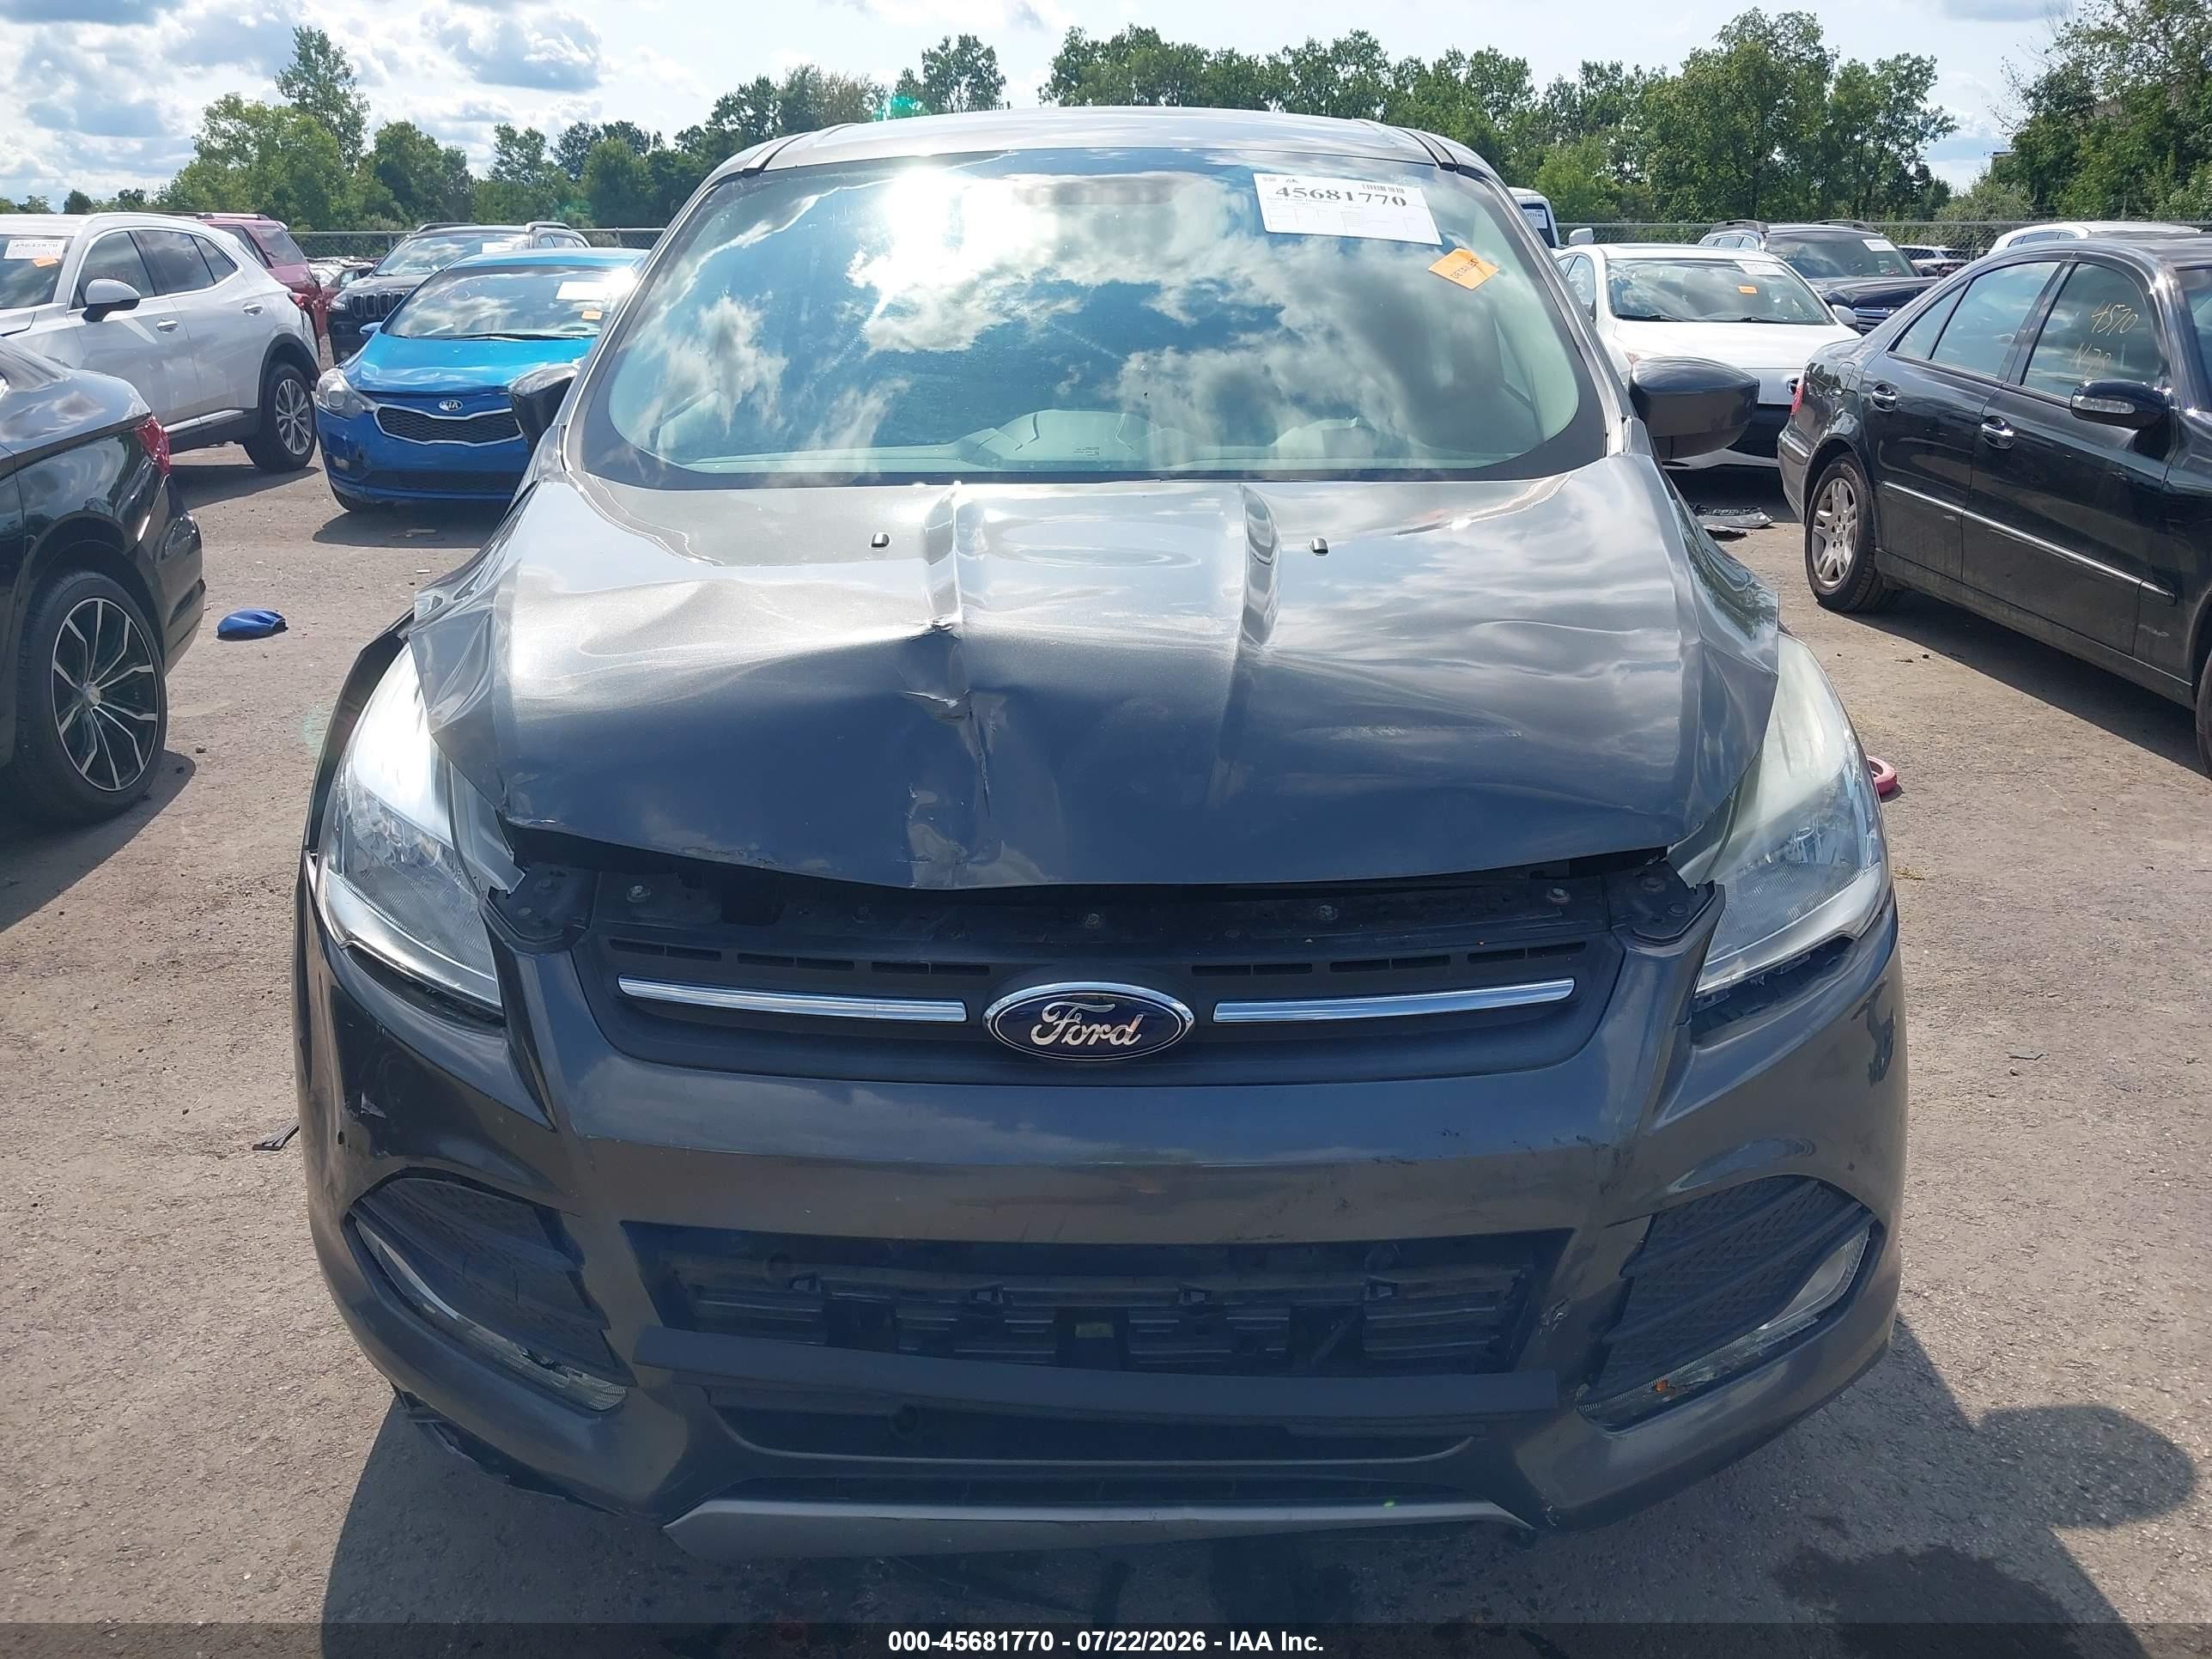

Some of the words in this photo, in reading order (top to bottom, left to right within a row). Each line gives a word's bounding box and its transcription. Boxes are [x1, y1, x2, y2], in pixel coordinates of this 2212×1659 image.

[1276, 186, 1407, 206] 45681770
[2091, 301, 2138, 336] 4570
[440, 400, 459, 410] KIA
[1030, 1001, 1146, 1045] Ford
